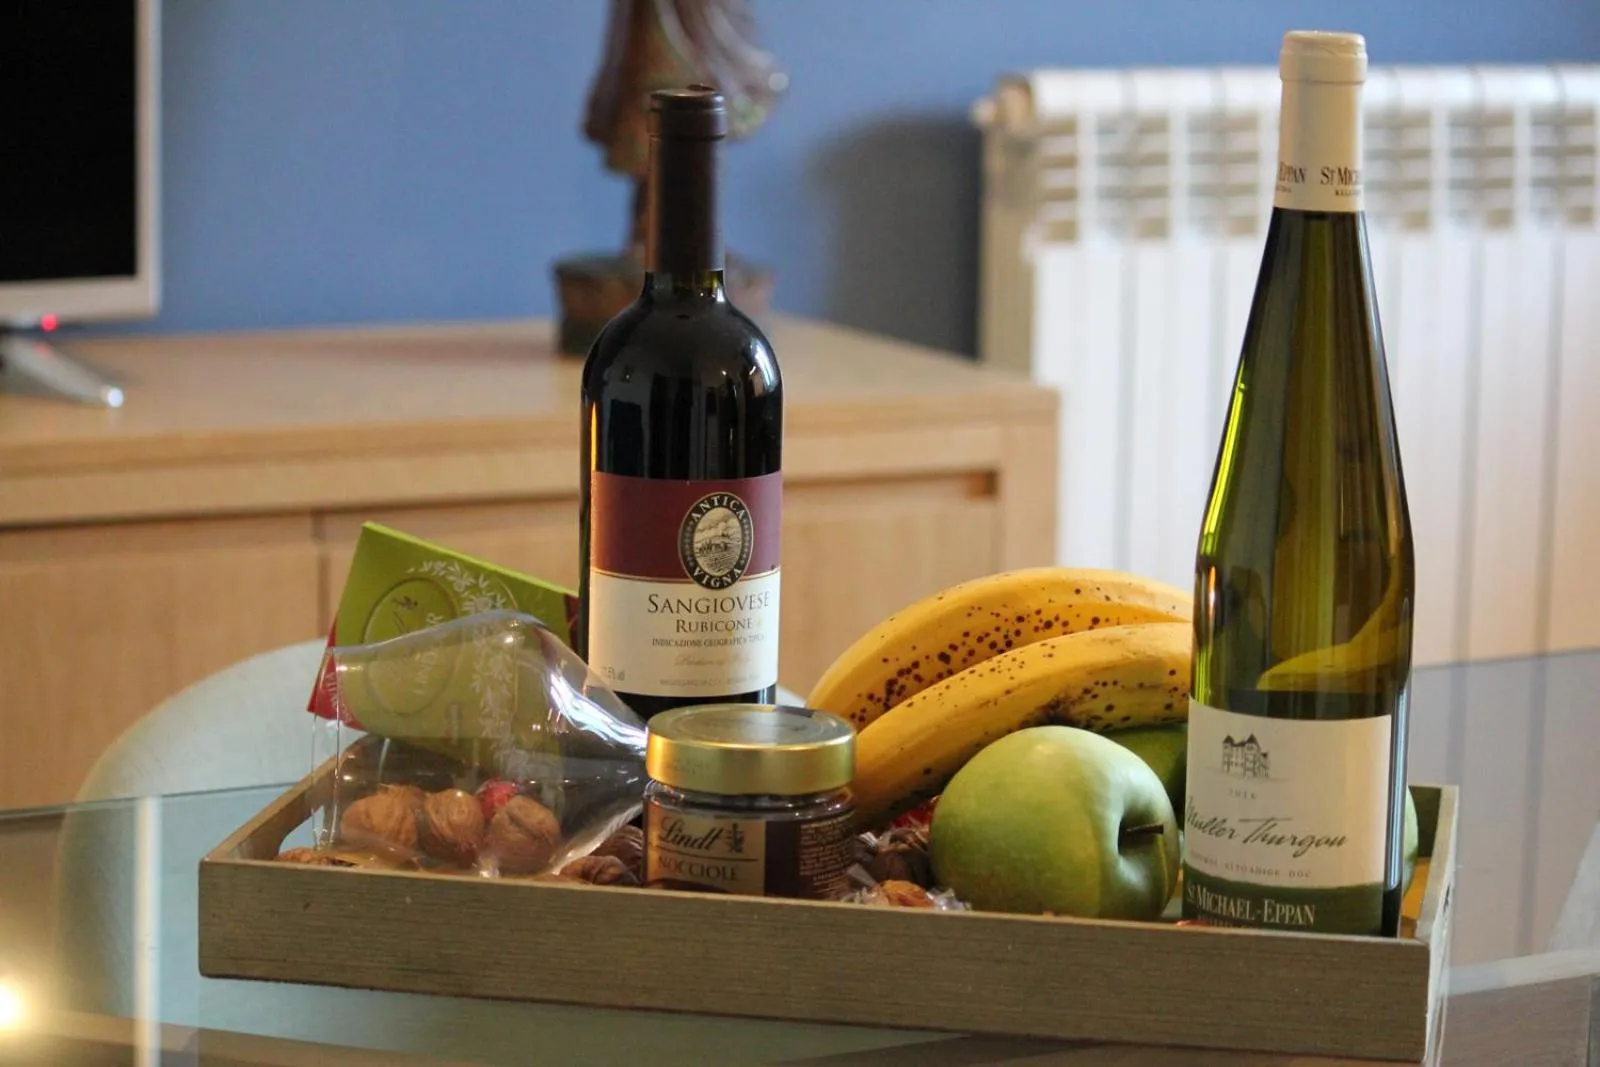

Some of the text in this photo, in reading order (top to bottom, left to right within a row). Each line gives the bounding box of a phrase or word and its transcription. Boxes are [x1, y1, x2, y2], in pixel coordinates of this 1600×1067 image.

[690, 495, 746, 524] ANTICA
[692, 568, 743, 589] VIGNA
[648, 591, 769, 615] SANGIOVESE
[676, 618, 753, 633] RUBICONE
[658, 817, 723, 852] Lindt
[1238, 817, 1349, 859] Thurgau
